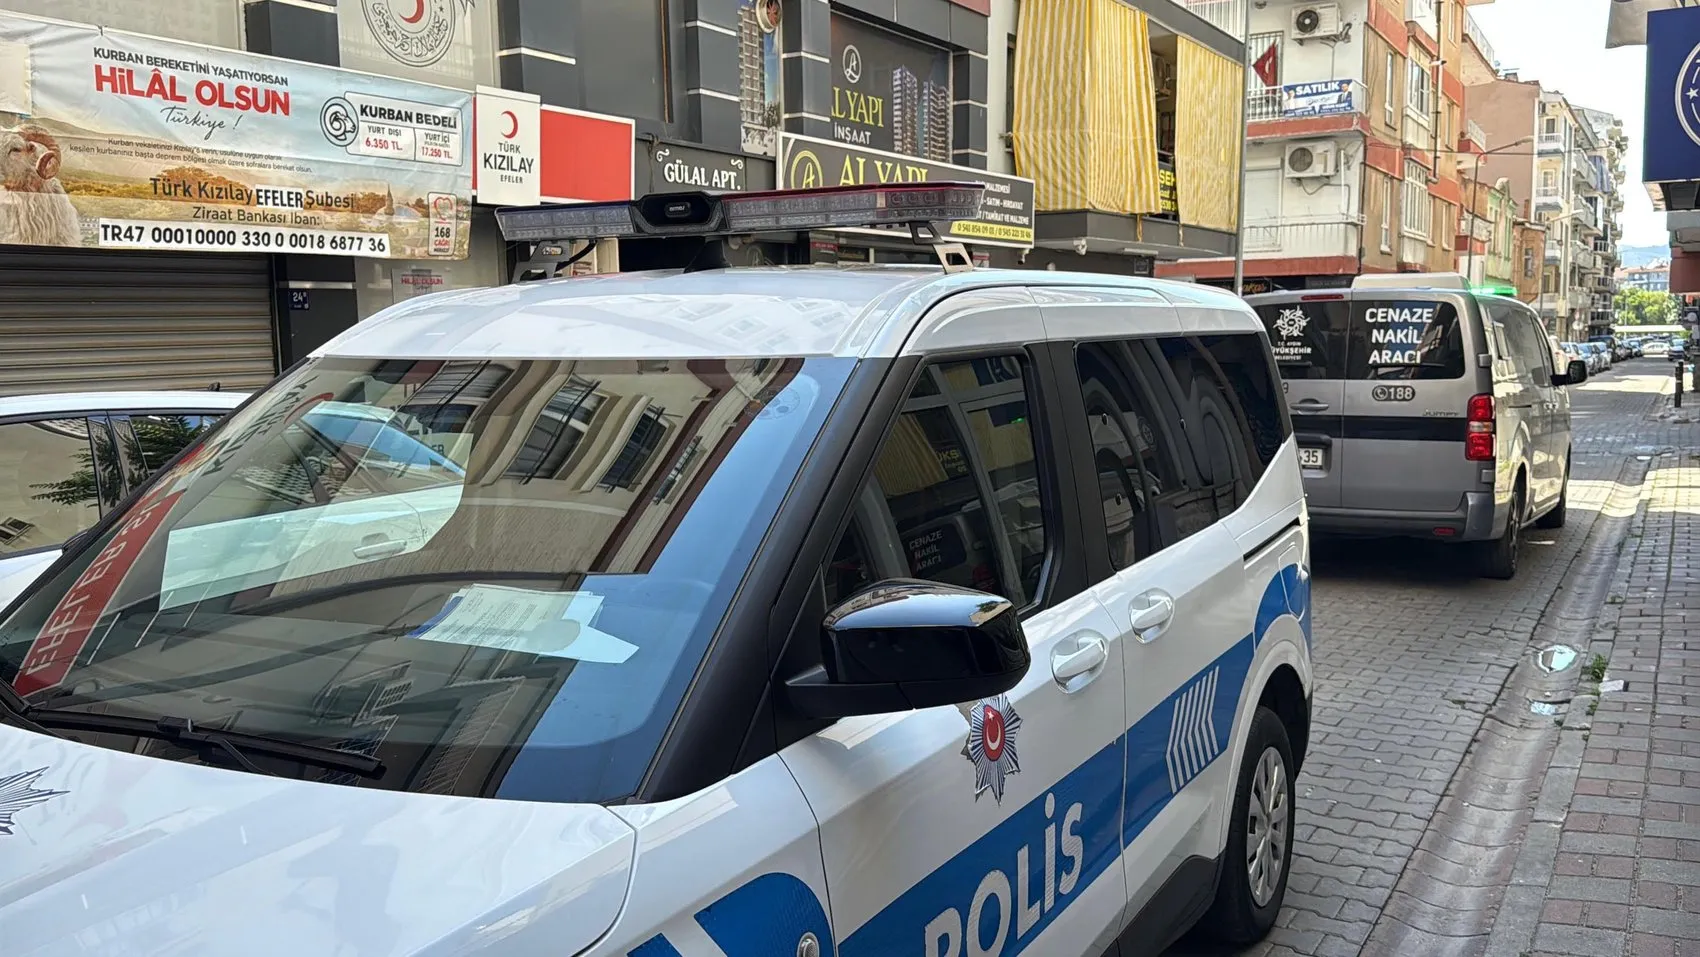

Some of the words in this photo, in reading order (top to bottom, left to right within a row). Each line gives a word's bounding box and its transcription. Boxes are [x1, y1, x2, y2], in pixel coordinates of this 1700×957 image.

[93, 47, 144, 64] KURBAN
[146, 55, 210, 75] BEREKETİNİ
[212, 66, 289, 86] YAŞATIYORSAN
[1295, 81, 1340, 96] SATILIK
[195, 80, 290, 116] OLSUN
[831, 86, 846, 119] L
[845, 90, 885, 128] YAPI
[160, 105, 226, 140] Türkiye
[360, 104, 413, 124] KURBAN
[415, 112, 457, 129] BEDELİ
[368, 125, 385, 135] YURT
[424, 132, 441, 142] YURT
[441, 132, 450, 143] İÇİ
[834, 121, 872, 145] İNŞAAT
[108, 137, 134, 147] Kurban
[365, 137, 389, 150] 6.350
[498, 141, 521, 154] TÜRK
[69, 144, 95, 153] kesilen
[96, 147, 133, 157] kurbanınız
[135, 150, 154, 159] başta
[155, 152, 181, 162] deprem
[227, 158, 246, 166] üzere
[421, 146, 442, 158] 17.250
[484, 152, 534, 174] KIZILAY
[500, 174, 523, 184] EFELER
[664, 159, 709, 186] GÜLAL
[712, 169, 741, 190] APT.
[150, 178, 192, 197] Türk
[198, 182, 252, 205] Kızılay
[256, 189, 303, 208] EFELER
[305, 190, 355, 209] Şubesi
[193, 206, 232, 221] Ziraat
[238, 209, 286, 224] Bankası
[101, 224, 144, 243] TR47
[151, 227, 236, 246] 00010000
[241, 231, 271, 247] 330
[275, 232, 284, 247] 0
[289, 233, 325, 249] 0018
[329, 235, 364, 251] 6877
[368, 237, 386, 253] 36
[434, 226, 451, 238] 168
[1365, 308, 1434, 323] CENAZE
[1371, 326, 1422, 344] NAKİL
[1270, 346, 1312, 355] ÜYÜKŞEHİR
[1368, 349, 1421, 364] ARACI
[1389, 387, 1412, 400] 188
[924, 792, 1083, 957] POLİS
